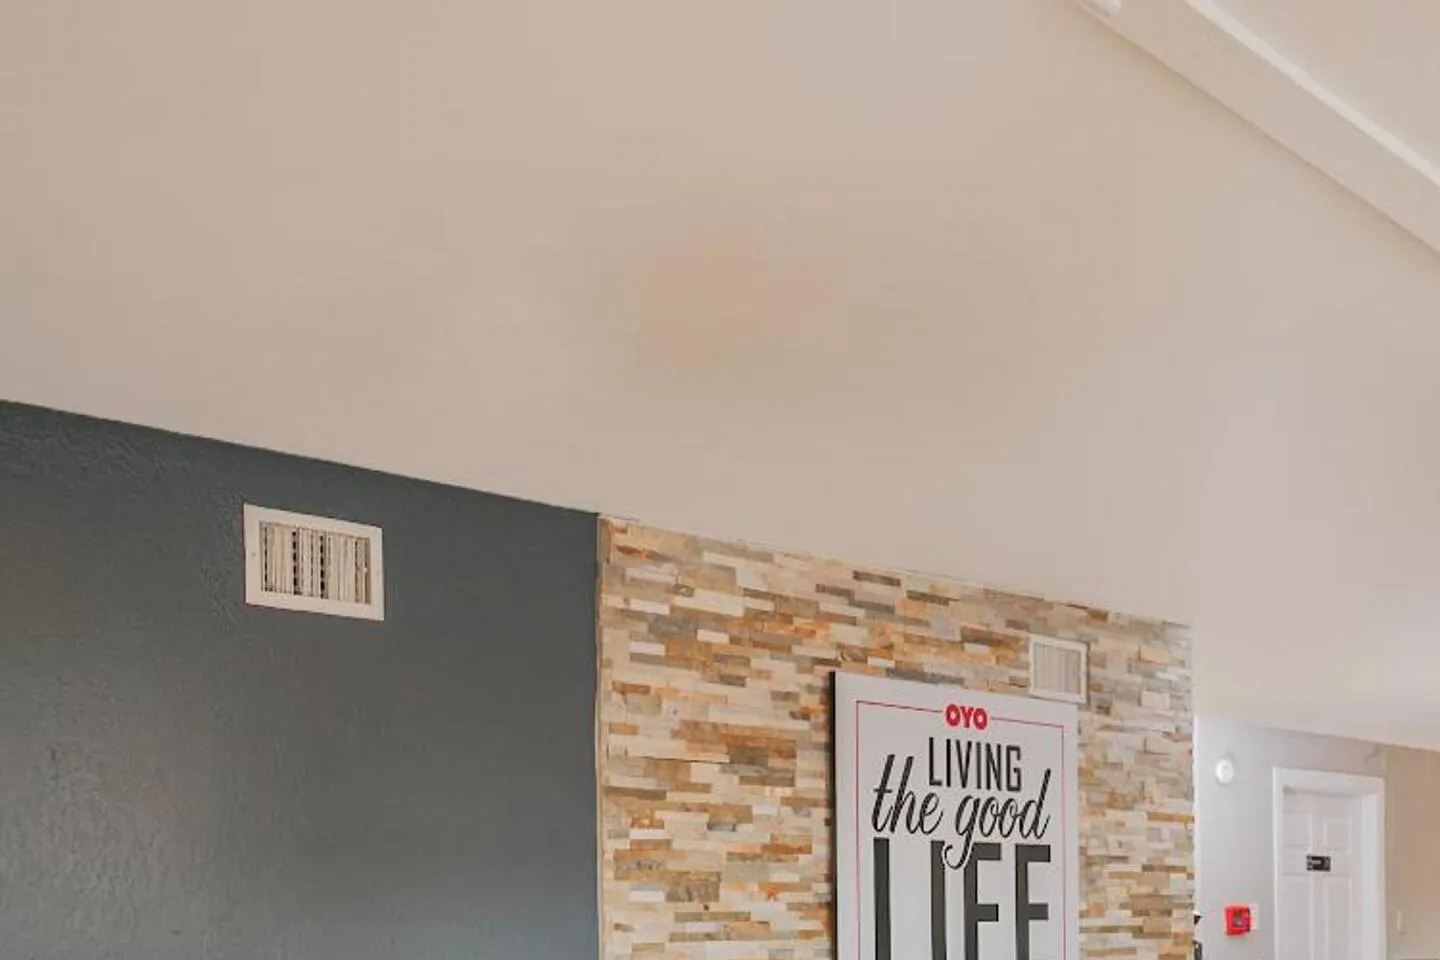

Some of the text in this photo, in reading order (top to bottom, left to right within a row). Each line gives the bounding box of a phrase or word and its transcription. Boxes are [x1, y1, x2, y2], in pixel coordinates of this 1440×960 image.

[945, 703, 989, 730] OYO
[928, 736, 1022, 792] LIVING
[871, 753, 1052, 870] the good
